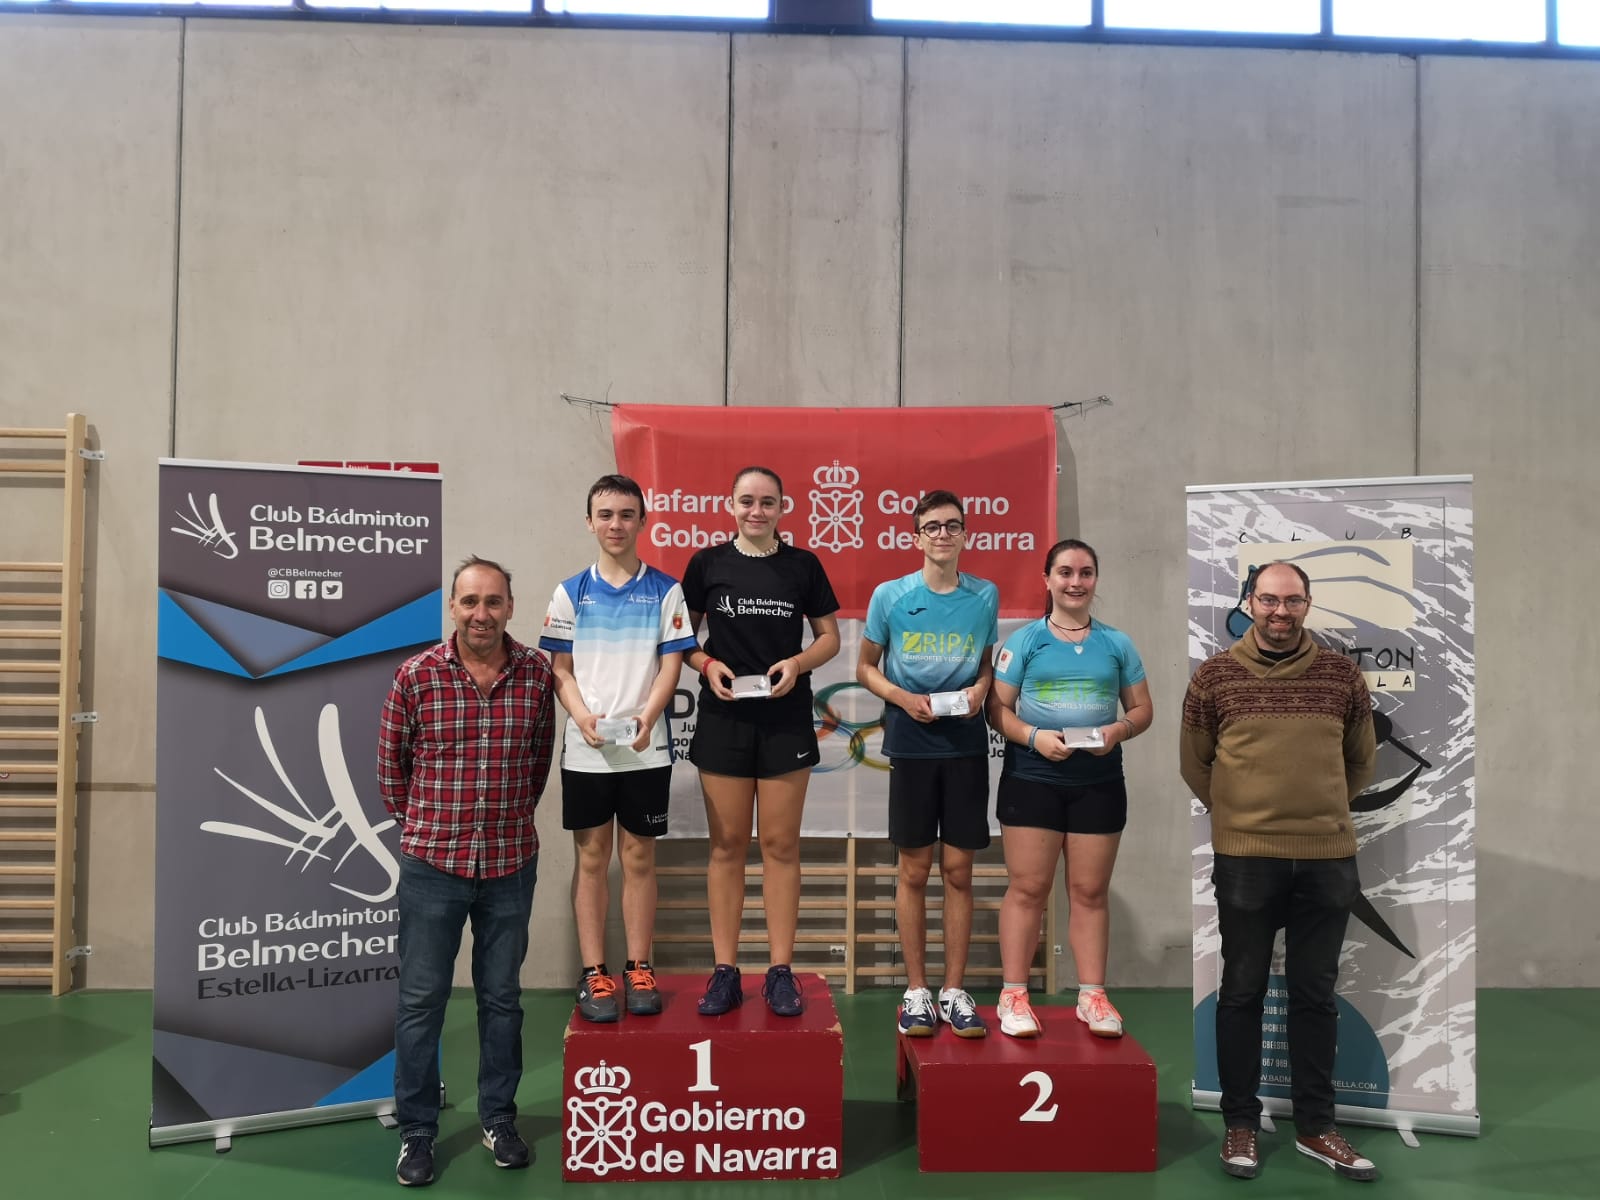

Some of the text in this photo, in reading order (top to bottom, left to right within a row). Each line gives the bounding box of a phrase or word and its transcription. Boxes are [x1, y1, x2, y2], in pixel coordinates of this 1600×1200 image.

[250, 504, 430, 527] Club Bádminton
[642, 488, 1009, 515] Nafarro Gorno
[250, 526, 429, 554] Belmecher
[877, 526, 913, 550] de
[267, 568, 343, 578] @CBBelmecher
[737, 605, 793, 618] Belmecher
[923, 632, 976, 654] RIPA
[199, 908, 400, 938] Club Bádminton
[198, 931, 398, 971] Belmecher
[197, 965, 400, 1000] Estella-Lizarra
[688, 1039, 720, 1092] 1
[1019, 1071, 1059, 1122] 2
[640, 1101, 805, 1132] Gobierno
[640, 1143, 837, 1173] de Navarra
